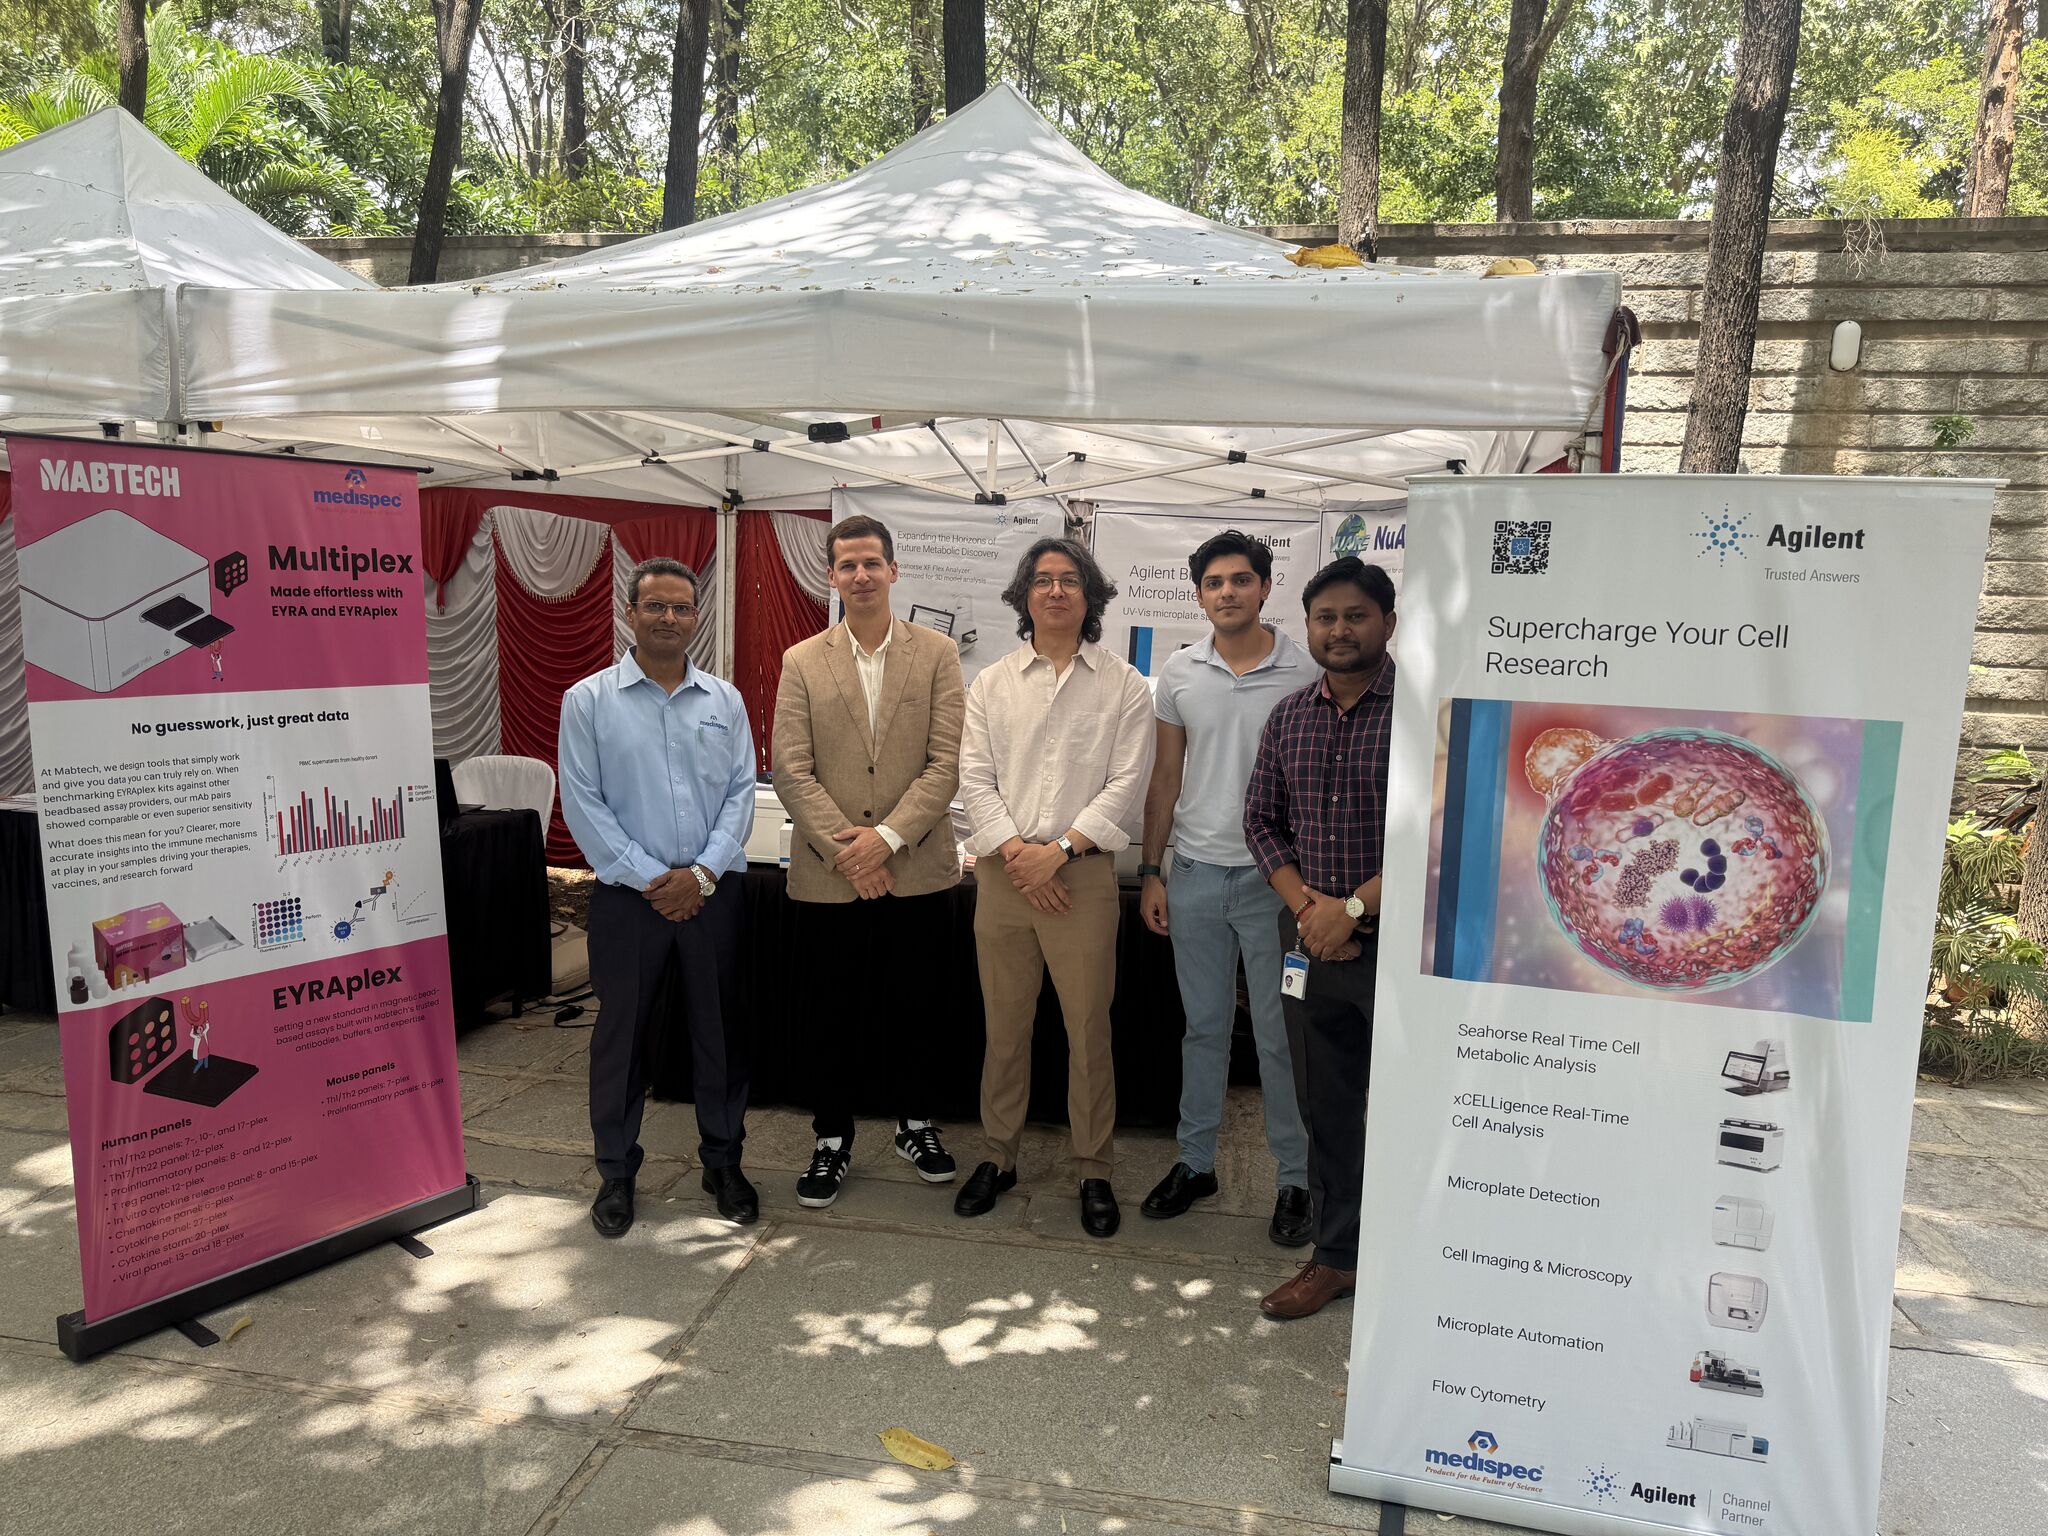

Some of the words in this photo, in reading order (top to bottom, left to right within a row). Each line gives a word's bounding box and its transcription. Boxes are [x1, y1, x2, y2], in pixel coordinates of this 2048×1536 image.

[40, 459, 180, 497] MABTECH
[314, 489, 401, 508] medispec
[1013, 516, 1038, 525] Agilent
[898, 531, 936, 543] Expanding
[939, 534, 950, 542] the
[952, 535, 986, 545] Horizons
[1257, 535, 1290, 547] gilent
[1374, 524, 1406, 550] NuA
[1767, 524, 1865, 552] Agilent
[268, 545, 414, 580] Multiplex
[897, 543, 921, 552] Future
[923, 545, 959, 555] Metabolic
[962, 548, 999, 560] Discovery
[1130, 565, 1174, 581] Agilent
[1277, 573, 1284, 585] 2
[1765, 568, 1806, 581] Trusted
[1810, 569, 1860, 583] Answers
[270, 586, 310, 597] Made
[314, 586, 374, 598] effortless
[376, 586, 403, 598] with
[1129, 585, 1197, 602] Microplate
[272, 606, 308, 616] EYRA
[312, 606, 336, 616] and
[339, 606, 398, 620] EYRAplex
[1123, 608, 1150, 616] UV-Vis
[1153, 610, 1198, 620] microplate
[1488, 616, 1656, 647] Supercharge
[1666, 621, 1729, 645] Your
[1737, 624, 1788, 648] Cell
[1486, 652, 1608, 677] Research
[132, 723, 151, 734] No
[156, 717, 244, 736] guesswork,
[247, 715, 274, 730] just
[277, 712, 314, 728] great
[317, 711, 349, 721] data
[41, 769, 51, 777] At
[55, 765, 101, 776] Mabtech,
[120, 762, 145, 771] design
[147, 759, 170, 768] tools
[173, 757, 189, 766] that
[191, 755, 218, 765] simply
[220, 753, 240, 762] work
[42, 781, 60, 790] and
[64, 781, 84, 790] give
[87, 780, 104, 789] you
[108, 776, 126, 785] data
[128, 776, 141, 785] you
[163, 770, 182, 780] truly
[185, 768, 199, 778] rely
[216, 765, 239, 774] When
[44, 791, 114, 803] benchmarking
[117, 786, 155, 797] EYRAplex
[158, 785, 174, 793] kits
[177, 781, 206, 792] against
[209, 779, 229, 787] other
[45, 805, 100, 816] beadbased
[104, 804, 127, 812] assay
[129, 799, 171, 811] providers,
[190, 793, 209, 802] mAb
[211, 791, 231, 802] pairs
[46, 818, 85, 830] showed
[89, 813, 138, 826] comparable
[177, 806, 209, 817] superior
[212, 802, 252, 812] sensitivity
[48, 839, 74, 849] What
[78, 838, 102, 846] does
[106, 835, 121, 844] this
[123, 833, 145, 841] mean
[149, 830, 161, 838] for
[164, 826, 184, 838] you?
[187, 825, 217, 834] Clearer,
[220, 822, 240, 830] more
[50, 852, 94, 862] accurate
[97, 847, 129, 858] insights
[132, 844, 149, 853] into
[152, 842, 166, 850] the
[169, 839, 203, 848] immune
[206, 832, 257, 843] mechanisms
[51, 868, 60, 876] at
[64, 866, 84, 877] play
[88, 865, 96, 873] in
[100, 863, 118, 873] your
[121, 857, 157, 868] samples
[160, 853, 188, 862] driving
[191, 851, 208, 860] your
[211, 845, 250, 856] therapies,
[273, 966, 402, 1010] EYRAplex
[1458, 1024, 1527, 1042] Seahorse
[1533, 1031, 1564, 1046] Real
[1569, 1035, 1607, 1051] Time
[1612, 1040, 1640, 1055] Cell
[1457, 1046, 1529, 1065] Metabolic
[1533, 1055, 1596, 1073] Analysis
[326, 1071, 360, 1087] Mouse
[362, 1062, 395, 1079] panels
[1454, 1093, 1548, 1115] xCELLigence
[1553, 1105, 1629, 1125] Real-Time
[102, 1132, 147, 1150] Human
[150, 1118, 192, 1140] panels
[1452, 1115, 1478, 1129] Cell
[1482, 1118, 1544, 1138] Analysis
[109, 1152, 146, 1168] Th1/Th2
[149, 1140, 183, 1158] panels:
[185, 1138, 197, 1147] 7-,
[200, 1132, 215, 1142] 10-,
[218, 1125, 235, 1136] and
[238, 1116, 268, 1131] 17-plex
[109, 1163, 157, 1183] Th17/Th22
[160, 1152, 189, 1169] panel:
[192, 1143, 224, 1158] 12-plex
[1448, 1176, 1524, 1197] Microplate
[1530, 1187, 1600, 1207] Detection
[1443, 1246, 1467, 1261] Cell
[1472, 1251, 1529, 1273] Imaging
[1533, 1260, 1543, 1272] &
[1548, 1262, 1632, 1288] Microscopy
[1437, 1316, 1513, 1338] Microplate
[1517, 1328, 1604, 1352] Automation
[1433, 1380, 1466, 1396] Flow
[1471, 1386, 1546, 1412] Cytometry
[1426, 1449, 1542, 1481] medispec
[1425, 1466, 1455, 1476] Products
[1482, 1477, 1505, 1486] Future
[1517, 1483, 1543, 1493] Science
[1631, 1482, 1696, 1507] Agilent
[1723, 1493, 1770, 1512] Channel
[1722, 1508, 1764, 1526] Partner
